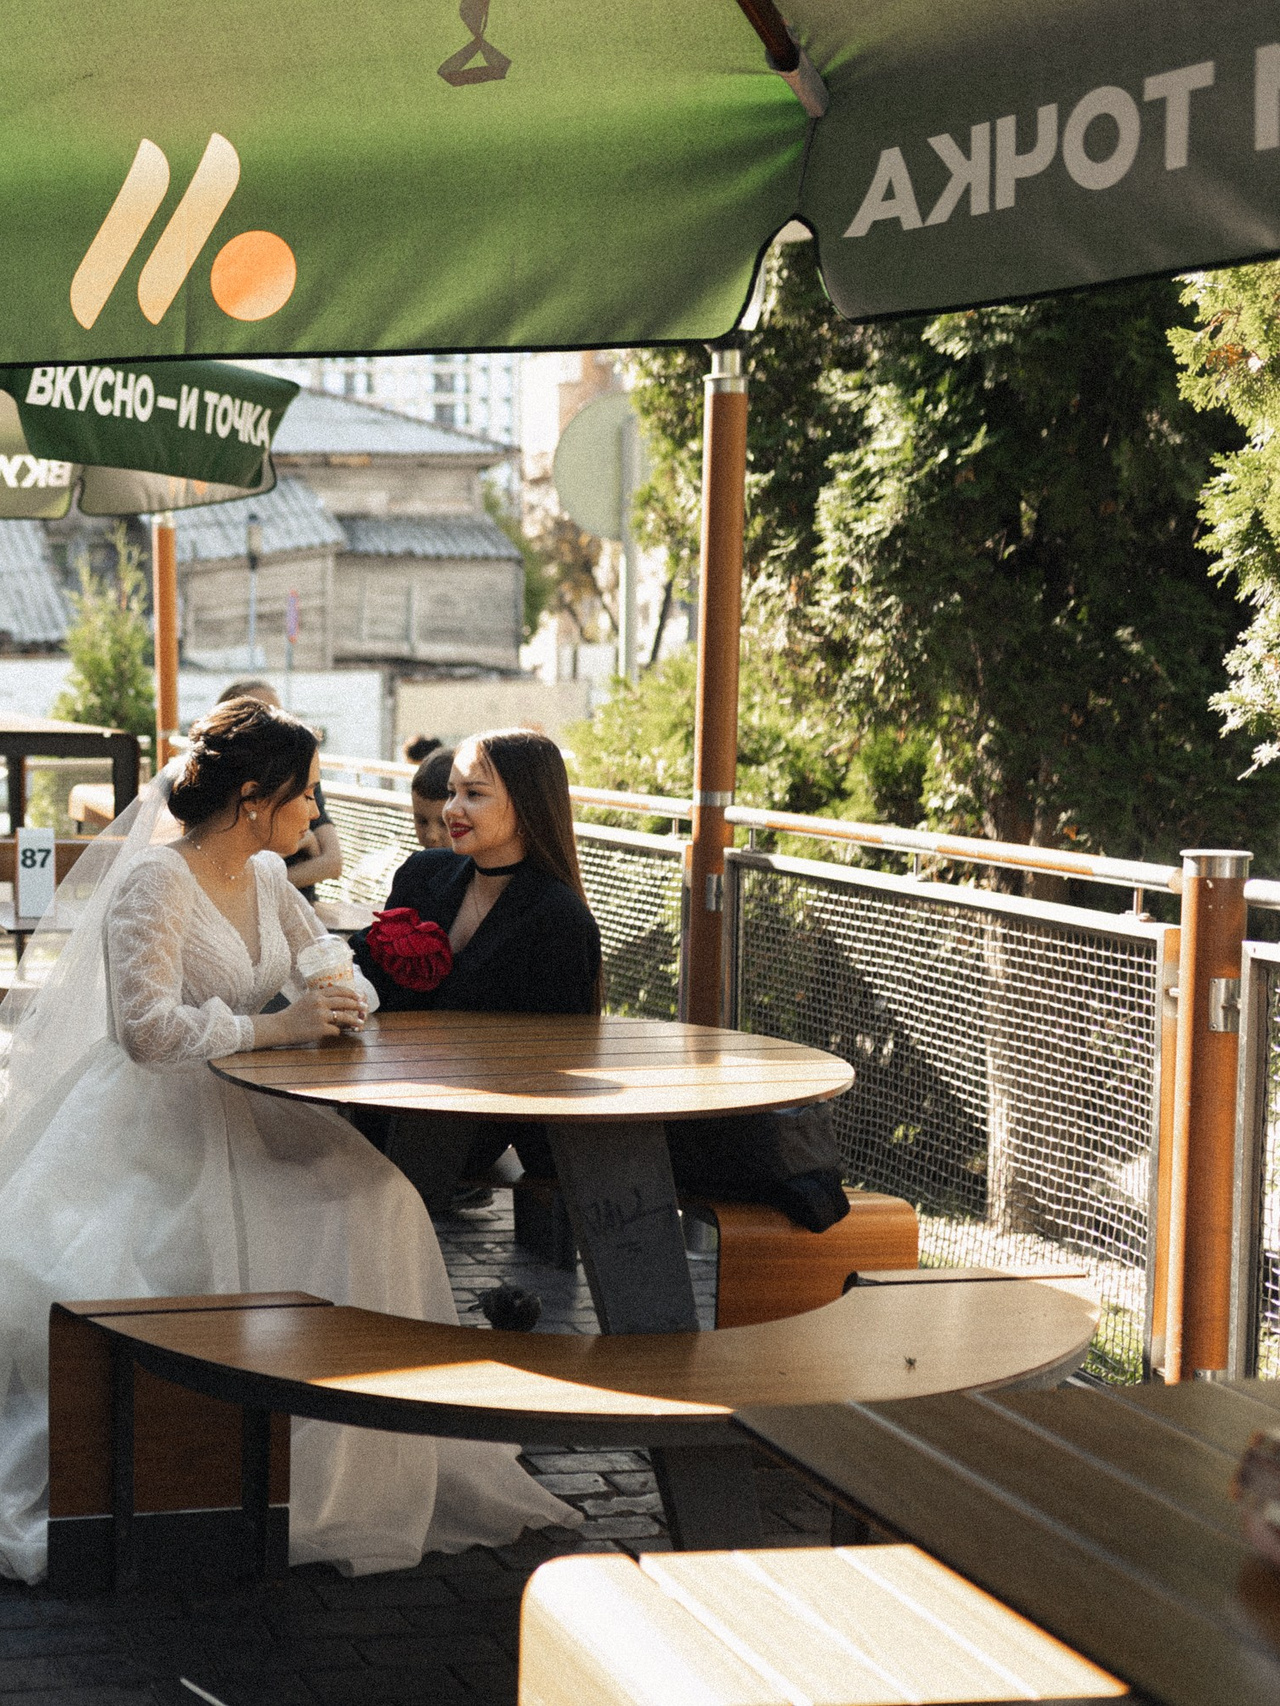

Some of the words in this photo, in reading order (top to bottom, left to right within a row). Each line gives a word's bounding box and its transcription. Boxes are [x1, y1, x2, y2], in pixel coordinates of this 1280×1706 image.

[24, 365, 155, 423] ВКУСНО
[178, 384, 199, 431] И
[203, 390, 272, 450] ТОЧКА
[20, 847, 52, 869] 87
